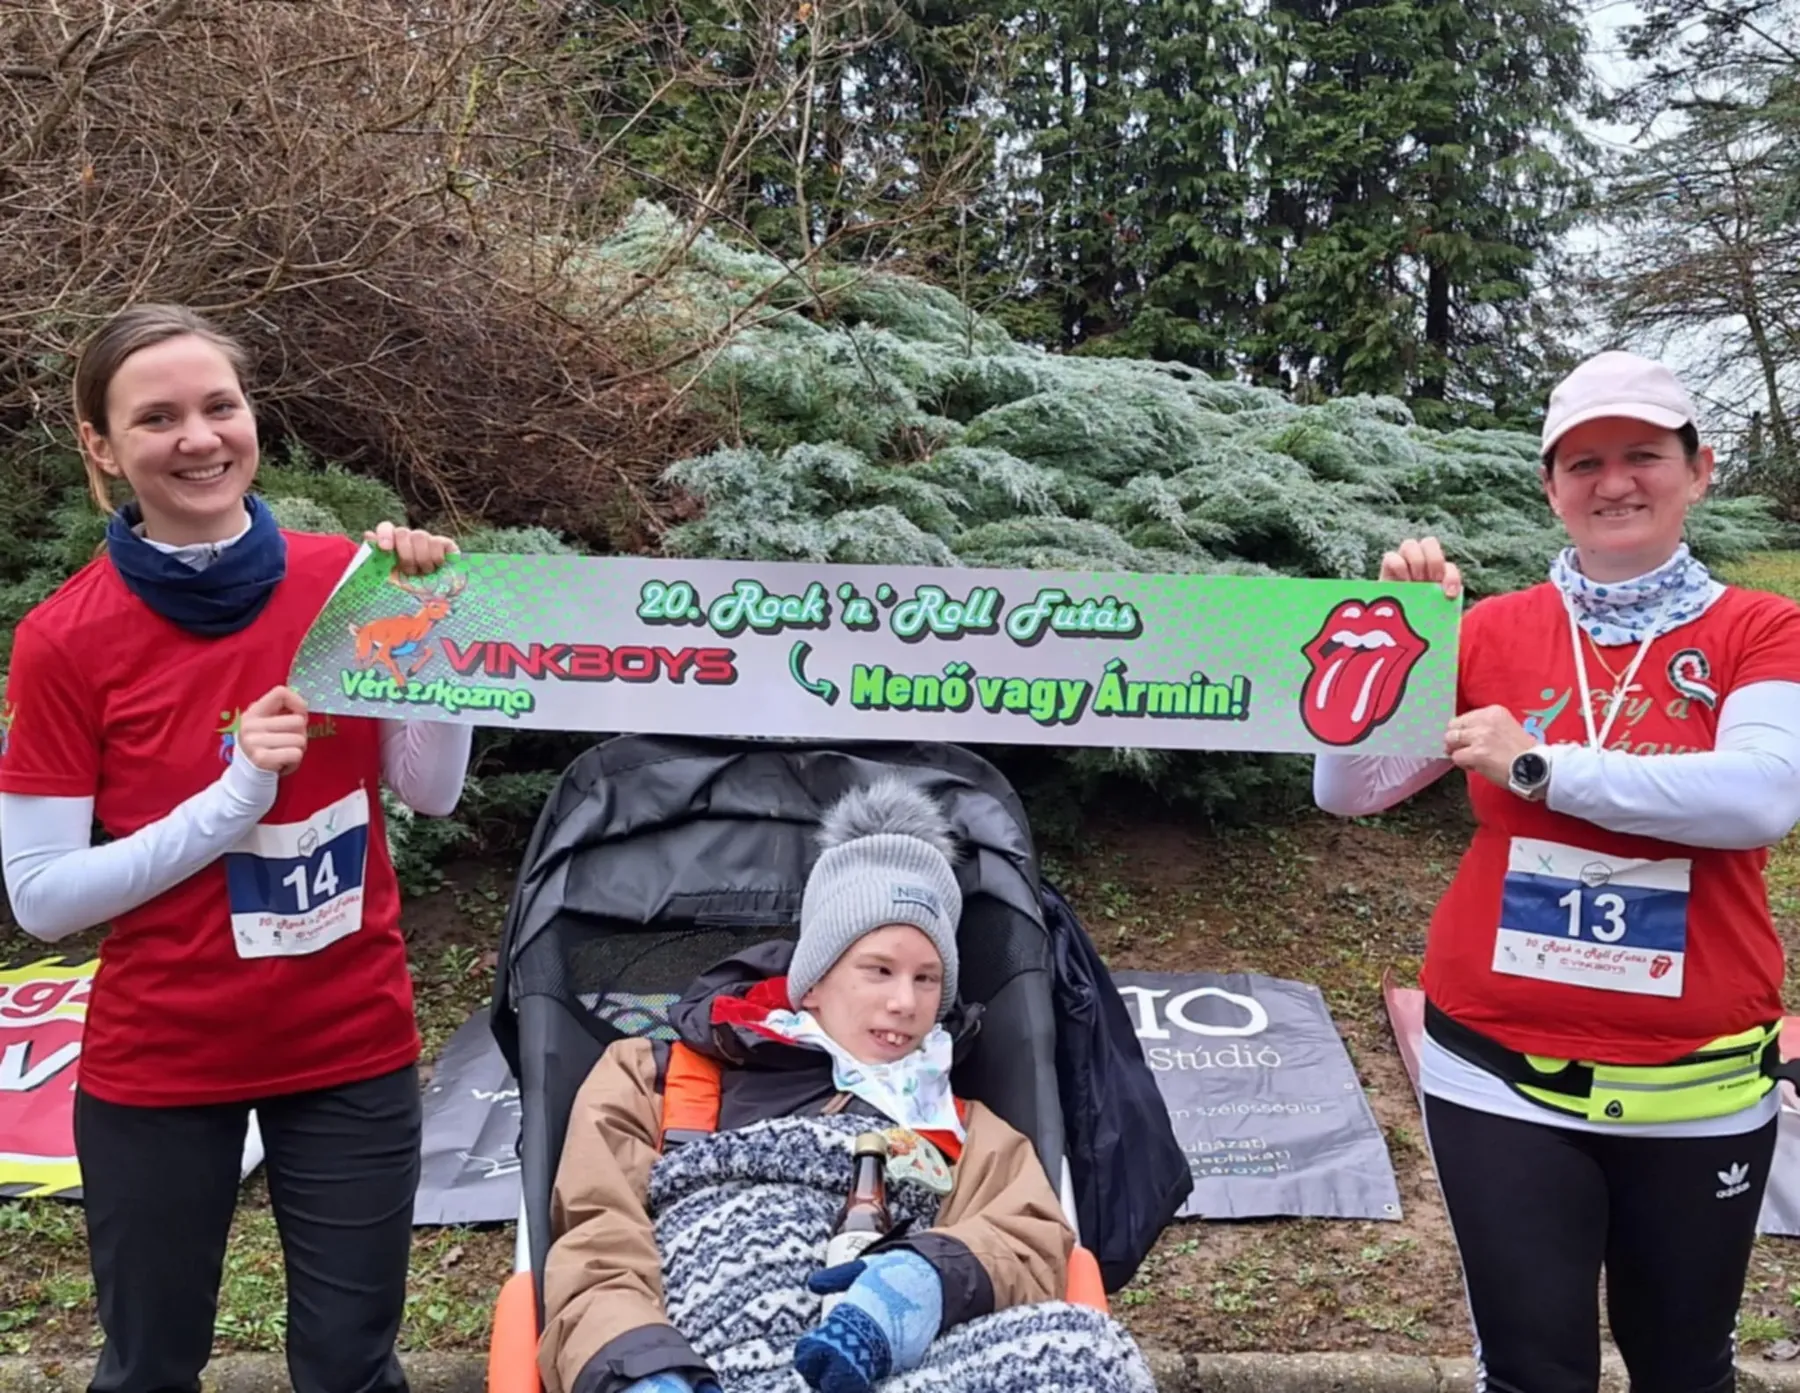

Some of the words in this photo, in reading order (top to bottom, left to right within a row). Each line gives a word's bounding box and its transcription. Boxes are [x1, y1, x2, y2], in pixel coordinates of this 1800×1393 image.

[638, 580, 702, 624] 20.
[708, 579, 830, 637] Rock
[891, 585, 1004, 640] Roll
[1006, 589, 1142, 646] Futás
[440, 637, 738, 685] VINKBOYS
[851, 662, 975, 709] Menő
[978, 673, 1092, 726] vagy
[1093, 658, 1250, 721] Ármin!
[283, 850, 340, 912] 14
[1558, 889, 1627, 943] 13
[1149, 1044, 1282, 1071] Stúdió
